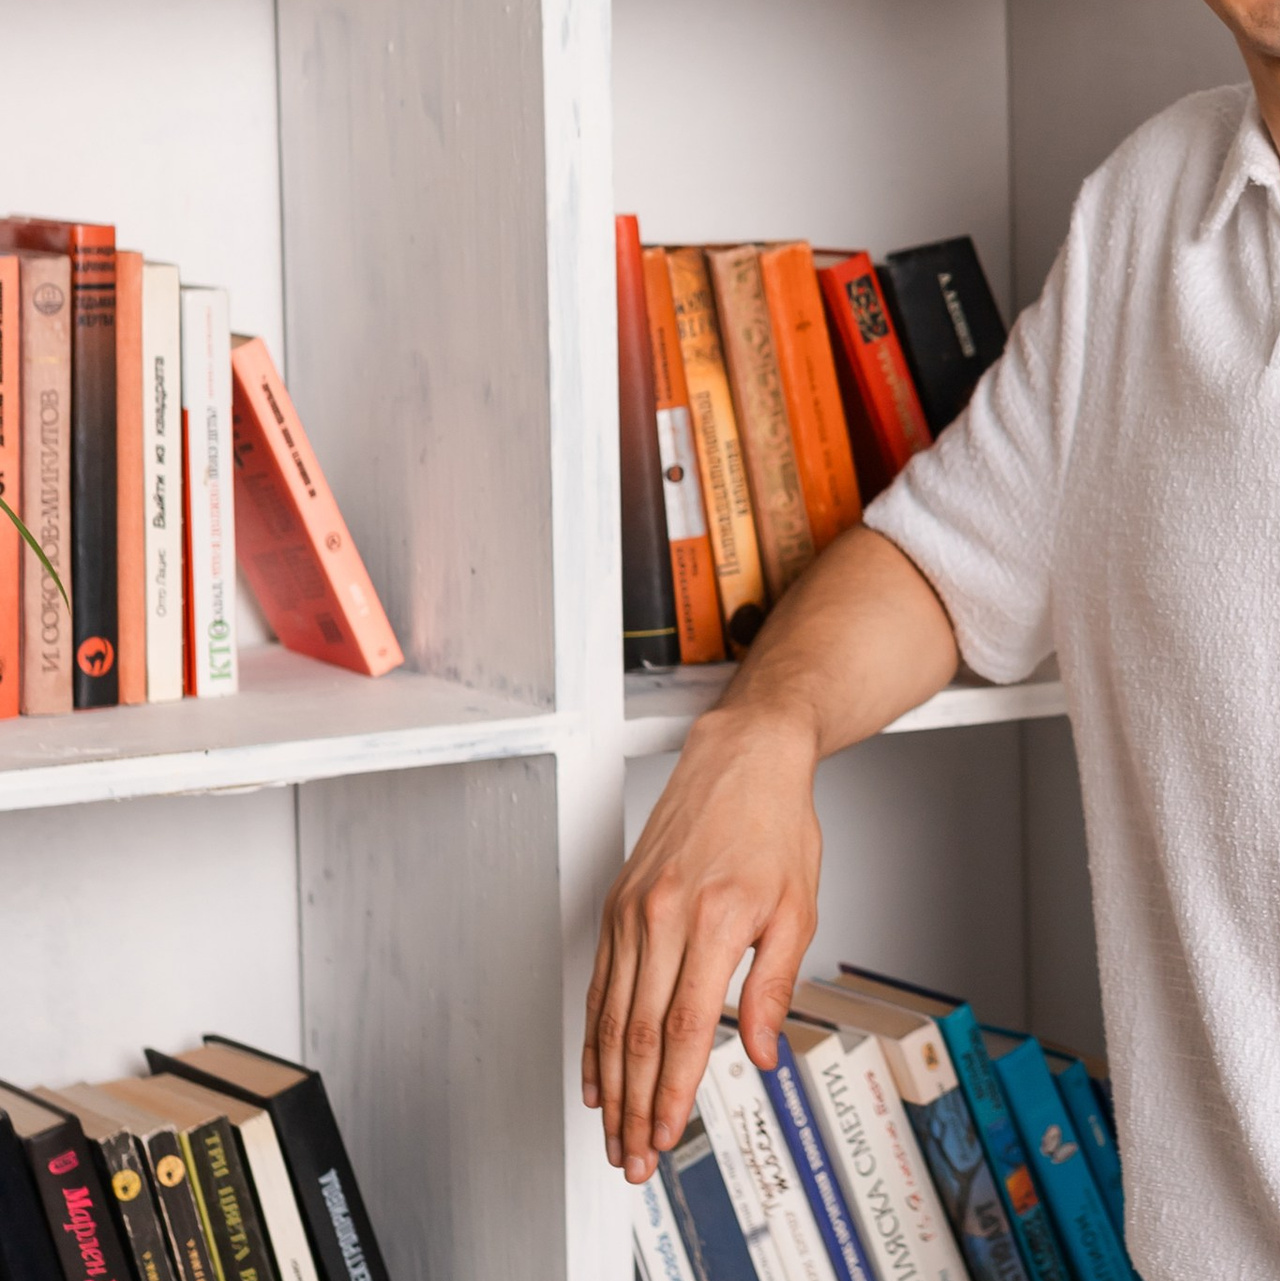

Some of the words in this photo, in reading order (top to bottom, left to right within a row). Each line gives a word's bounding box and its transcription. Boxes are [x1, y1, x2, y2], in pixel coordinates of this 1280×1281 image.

[151, 355, 168, 439] квадрата
[151, 475, 167, 531] Выйти
[207, 620, 232, 681] КТО
[200, 1129, 230, 1179] ТРИ
[816, 1058, 882, 1180] СМЕРТИ
[56, 1180, 114, 1281] Марлен
[213, 1183, 254, 1262] ЦВЕТА
